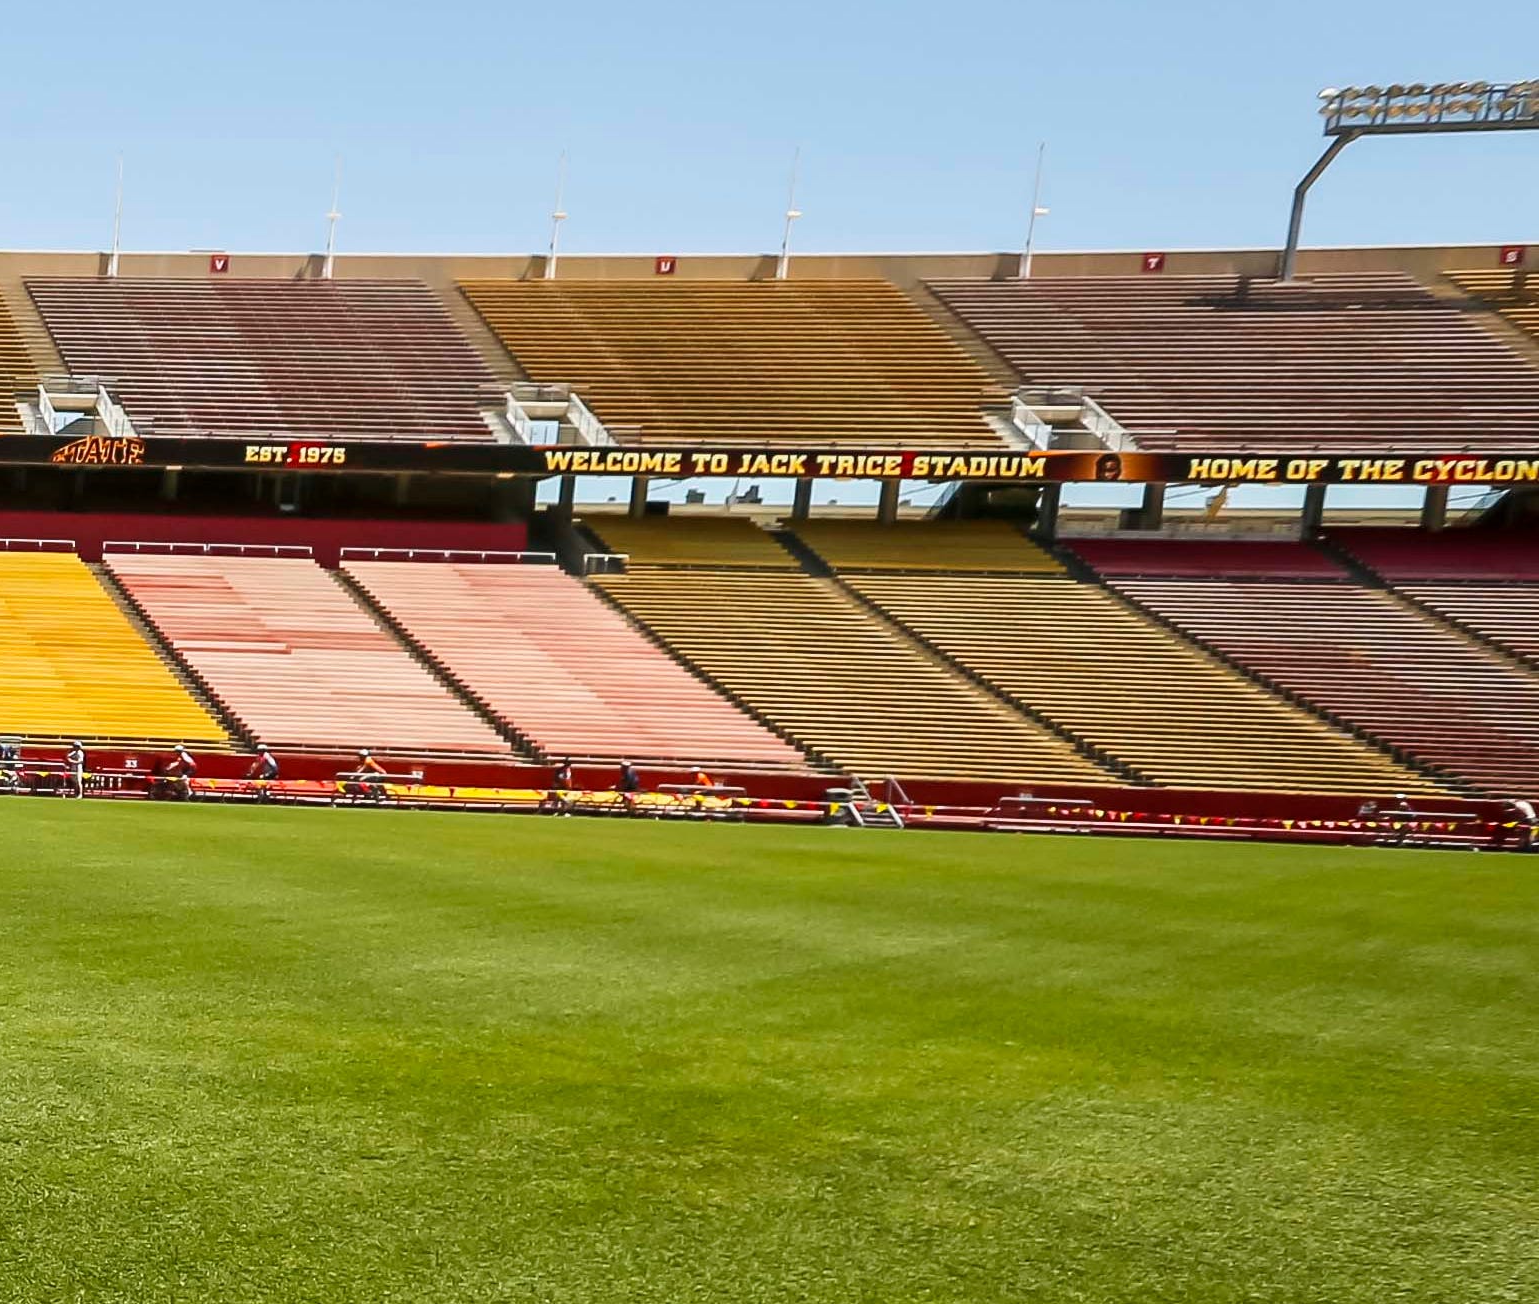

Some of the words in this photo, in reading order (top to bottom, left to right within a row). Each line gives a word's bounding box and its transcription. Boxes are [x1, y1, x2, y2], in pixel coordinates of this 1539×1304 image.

[245, 445, 293, 463] EST.
[298, 447, 346, 464] 1975
[544, 451, 682, 473] WELCOME
[691, 453, 729, 473] TO
[737, 454, 808, 474] JACK
[816, 455, 903, 476] TRICE
[911, 455, 1047, 477] STADIUM
[1188, 458, 1279, 479] HOME
[1286, 459, 1329, 480] OF
[1337, 459, 1405, 480] THE
[1413, 460, 1539, 481] CYCLON
